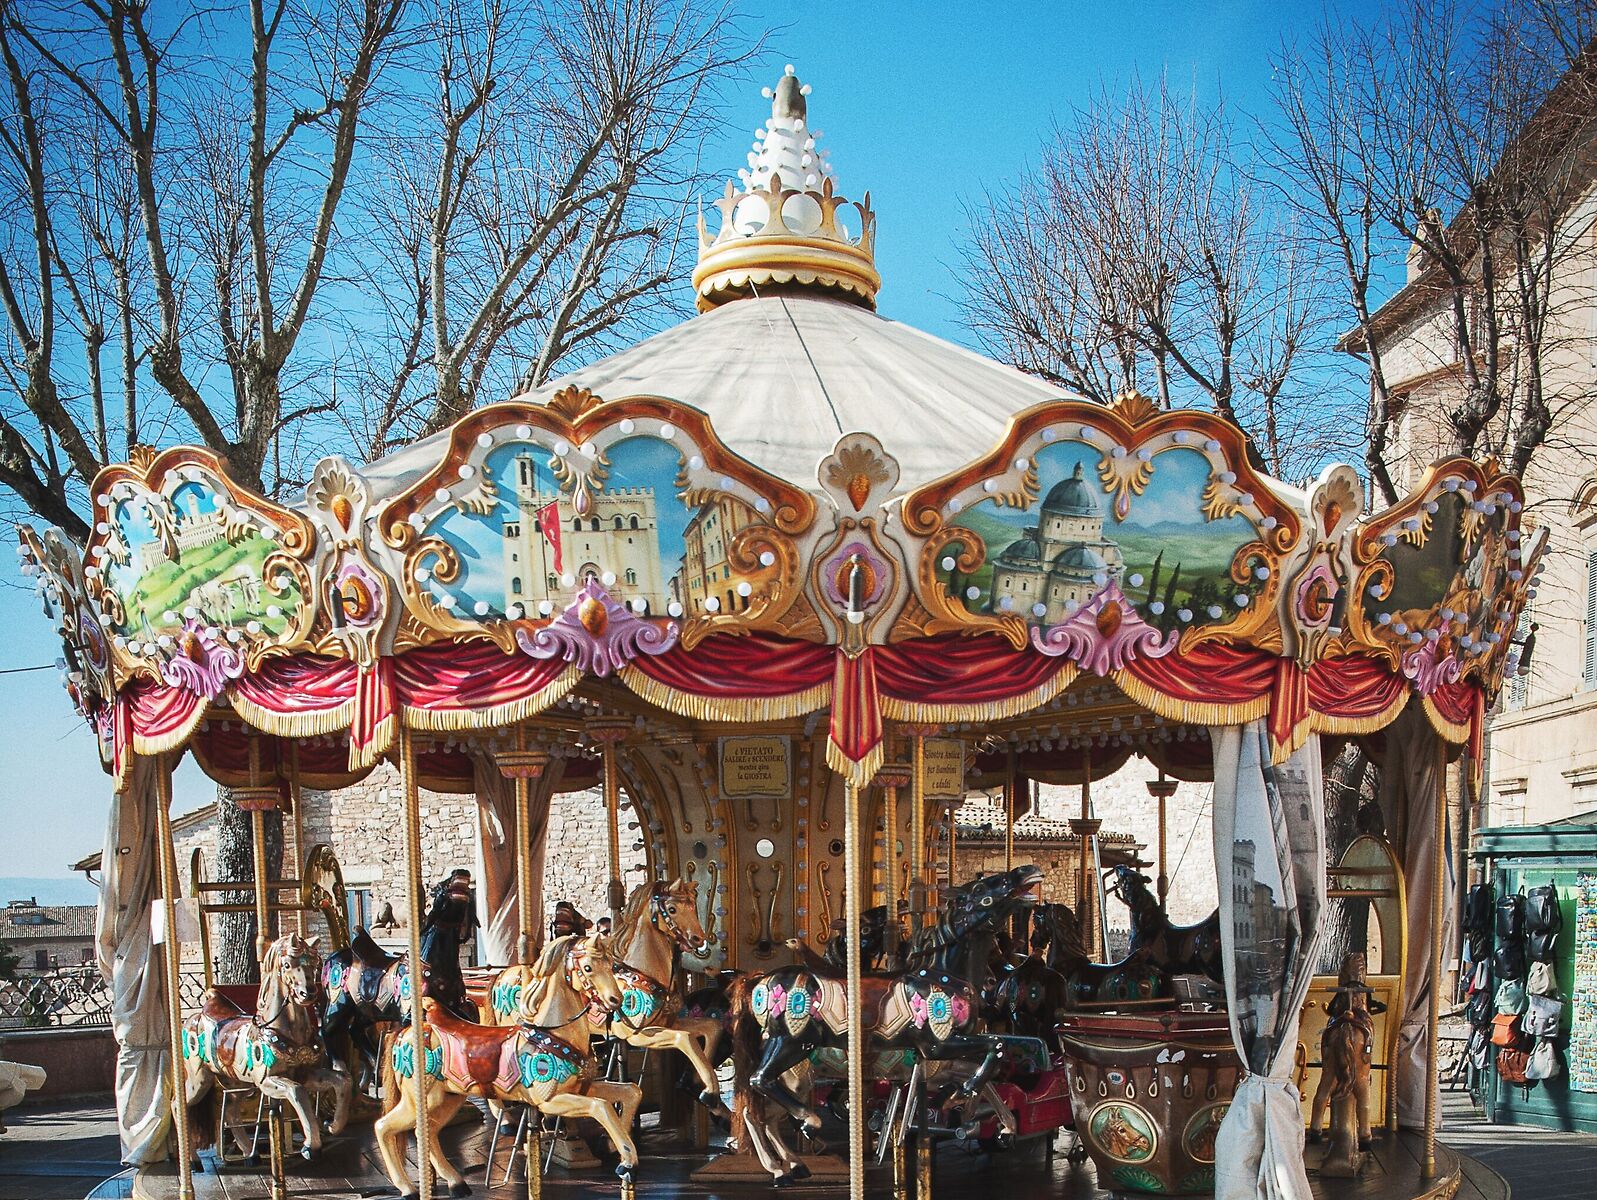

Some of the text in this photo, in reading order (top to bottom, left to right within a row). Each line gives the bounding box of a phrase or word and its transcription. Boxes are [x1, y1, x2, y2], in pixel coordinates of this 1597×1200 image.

[740, 746, 773, 755] VIETATO
[725, 755, 746, 763] SALIRE
[758, 764, 769, 773] gira
